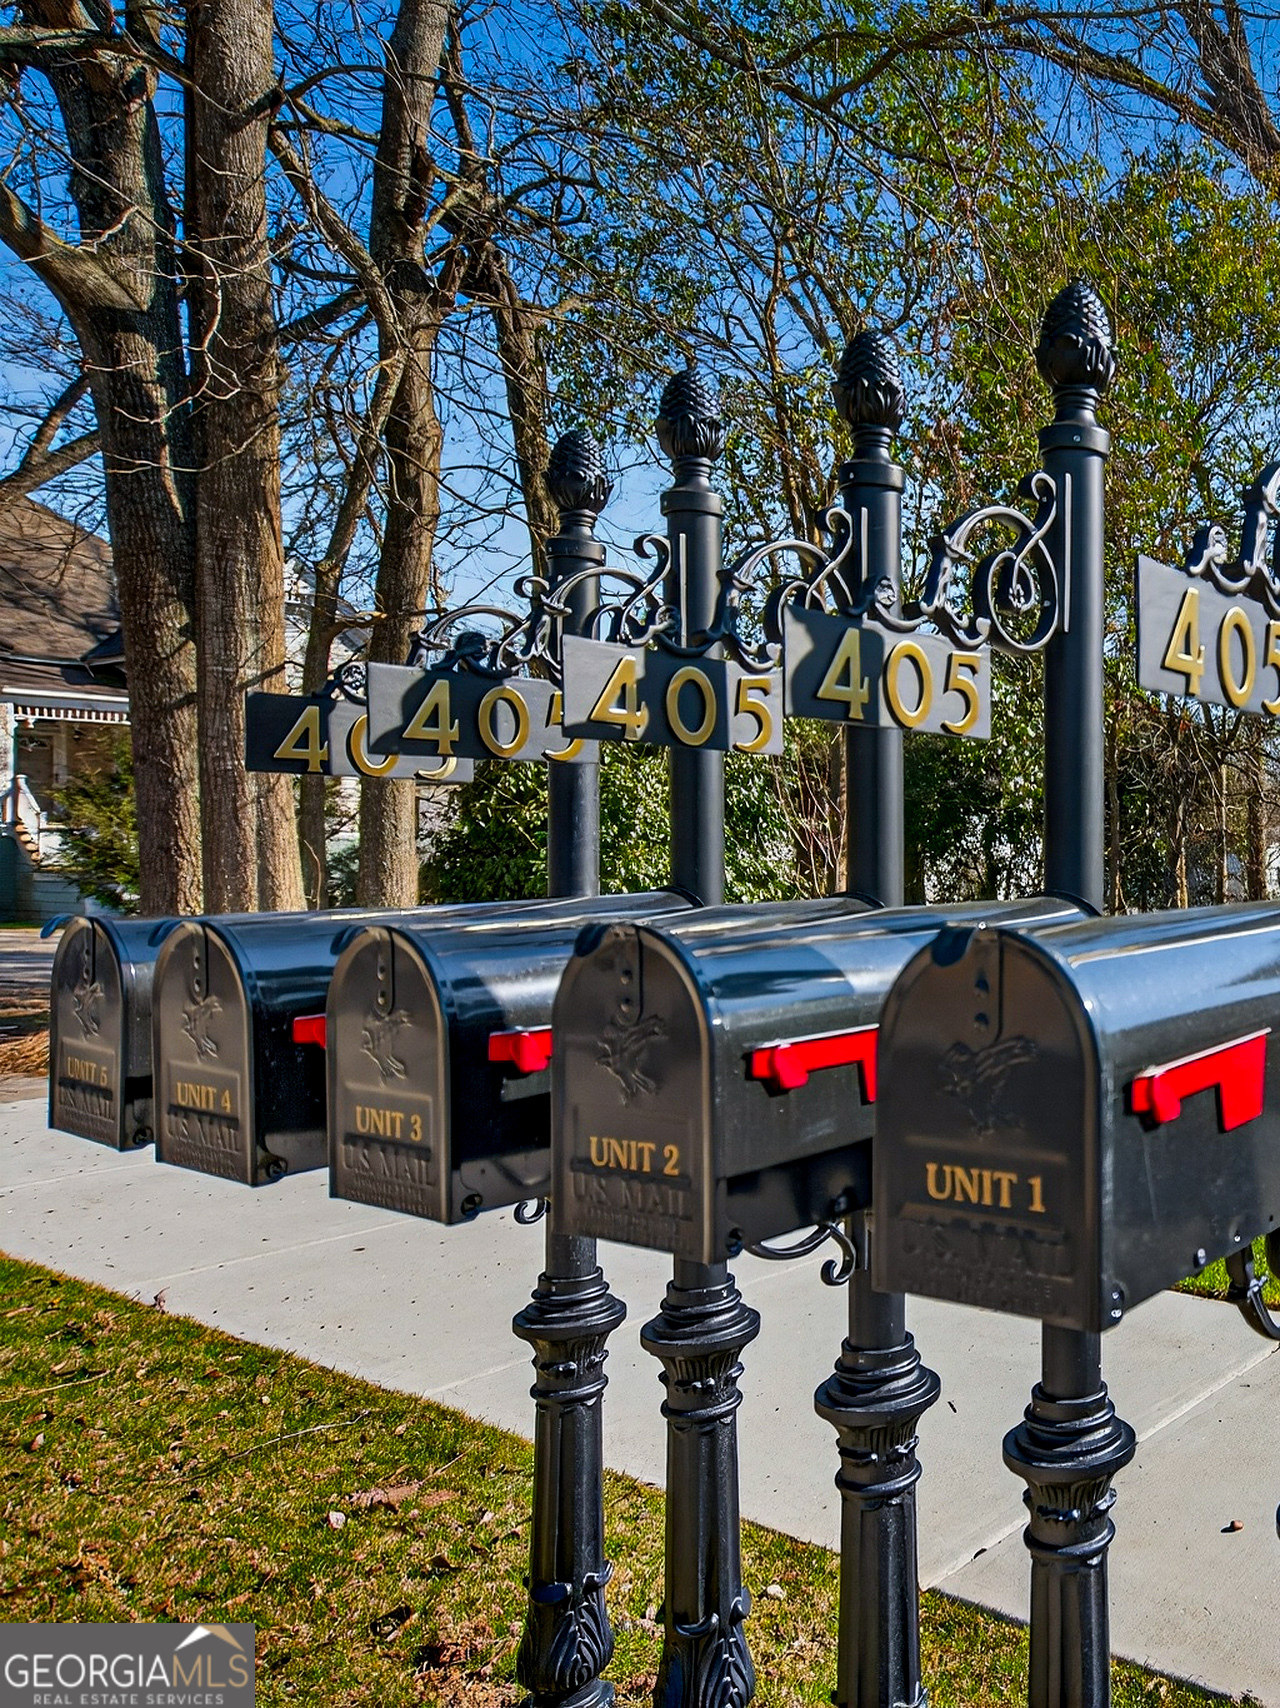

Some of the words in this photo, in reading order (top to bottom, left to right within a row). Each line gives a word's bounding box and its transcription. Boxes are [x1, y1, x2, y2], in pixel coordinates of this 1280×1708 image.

[590, 655, 773, 753] 405
[817, 628, 981, 735] 405
[274, 706, 457, 780] 40
[67, 1057, 97, 1084] UNIT
[176, 1081, 217, 1110] UNIT
[221, 1089, 231, 1113] 4
[355, 1105, 404, 1139] UNIT
[410, 1114, 422, 1141] 3
[589, 1136, 656, 1172] UNIT
[663, 1144, 680, 1176] 2
[926, 1162, 1018, 1208] UNIT
[1028, 1176, 1046, 1213] 1
